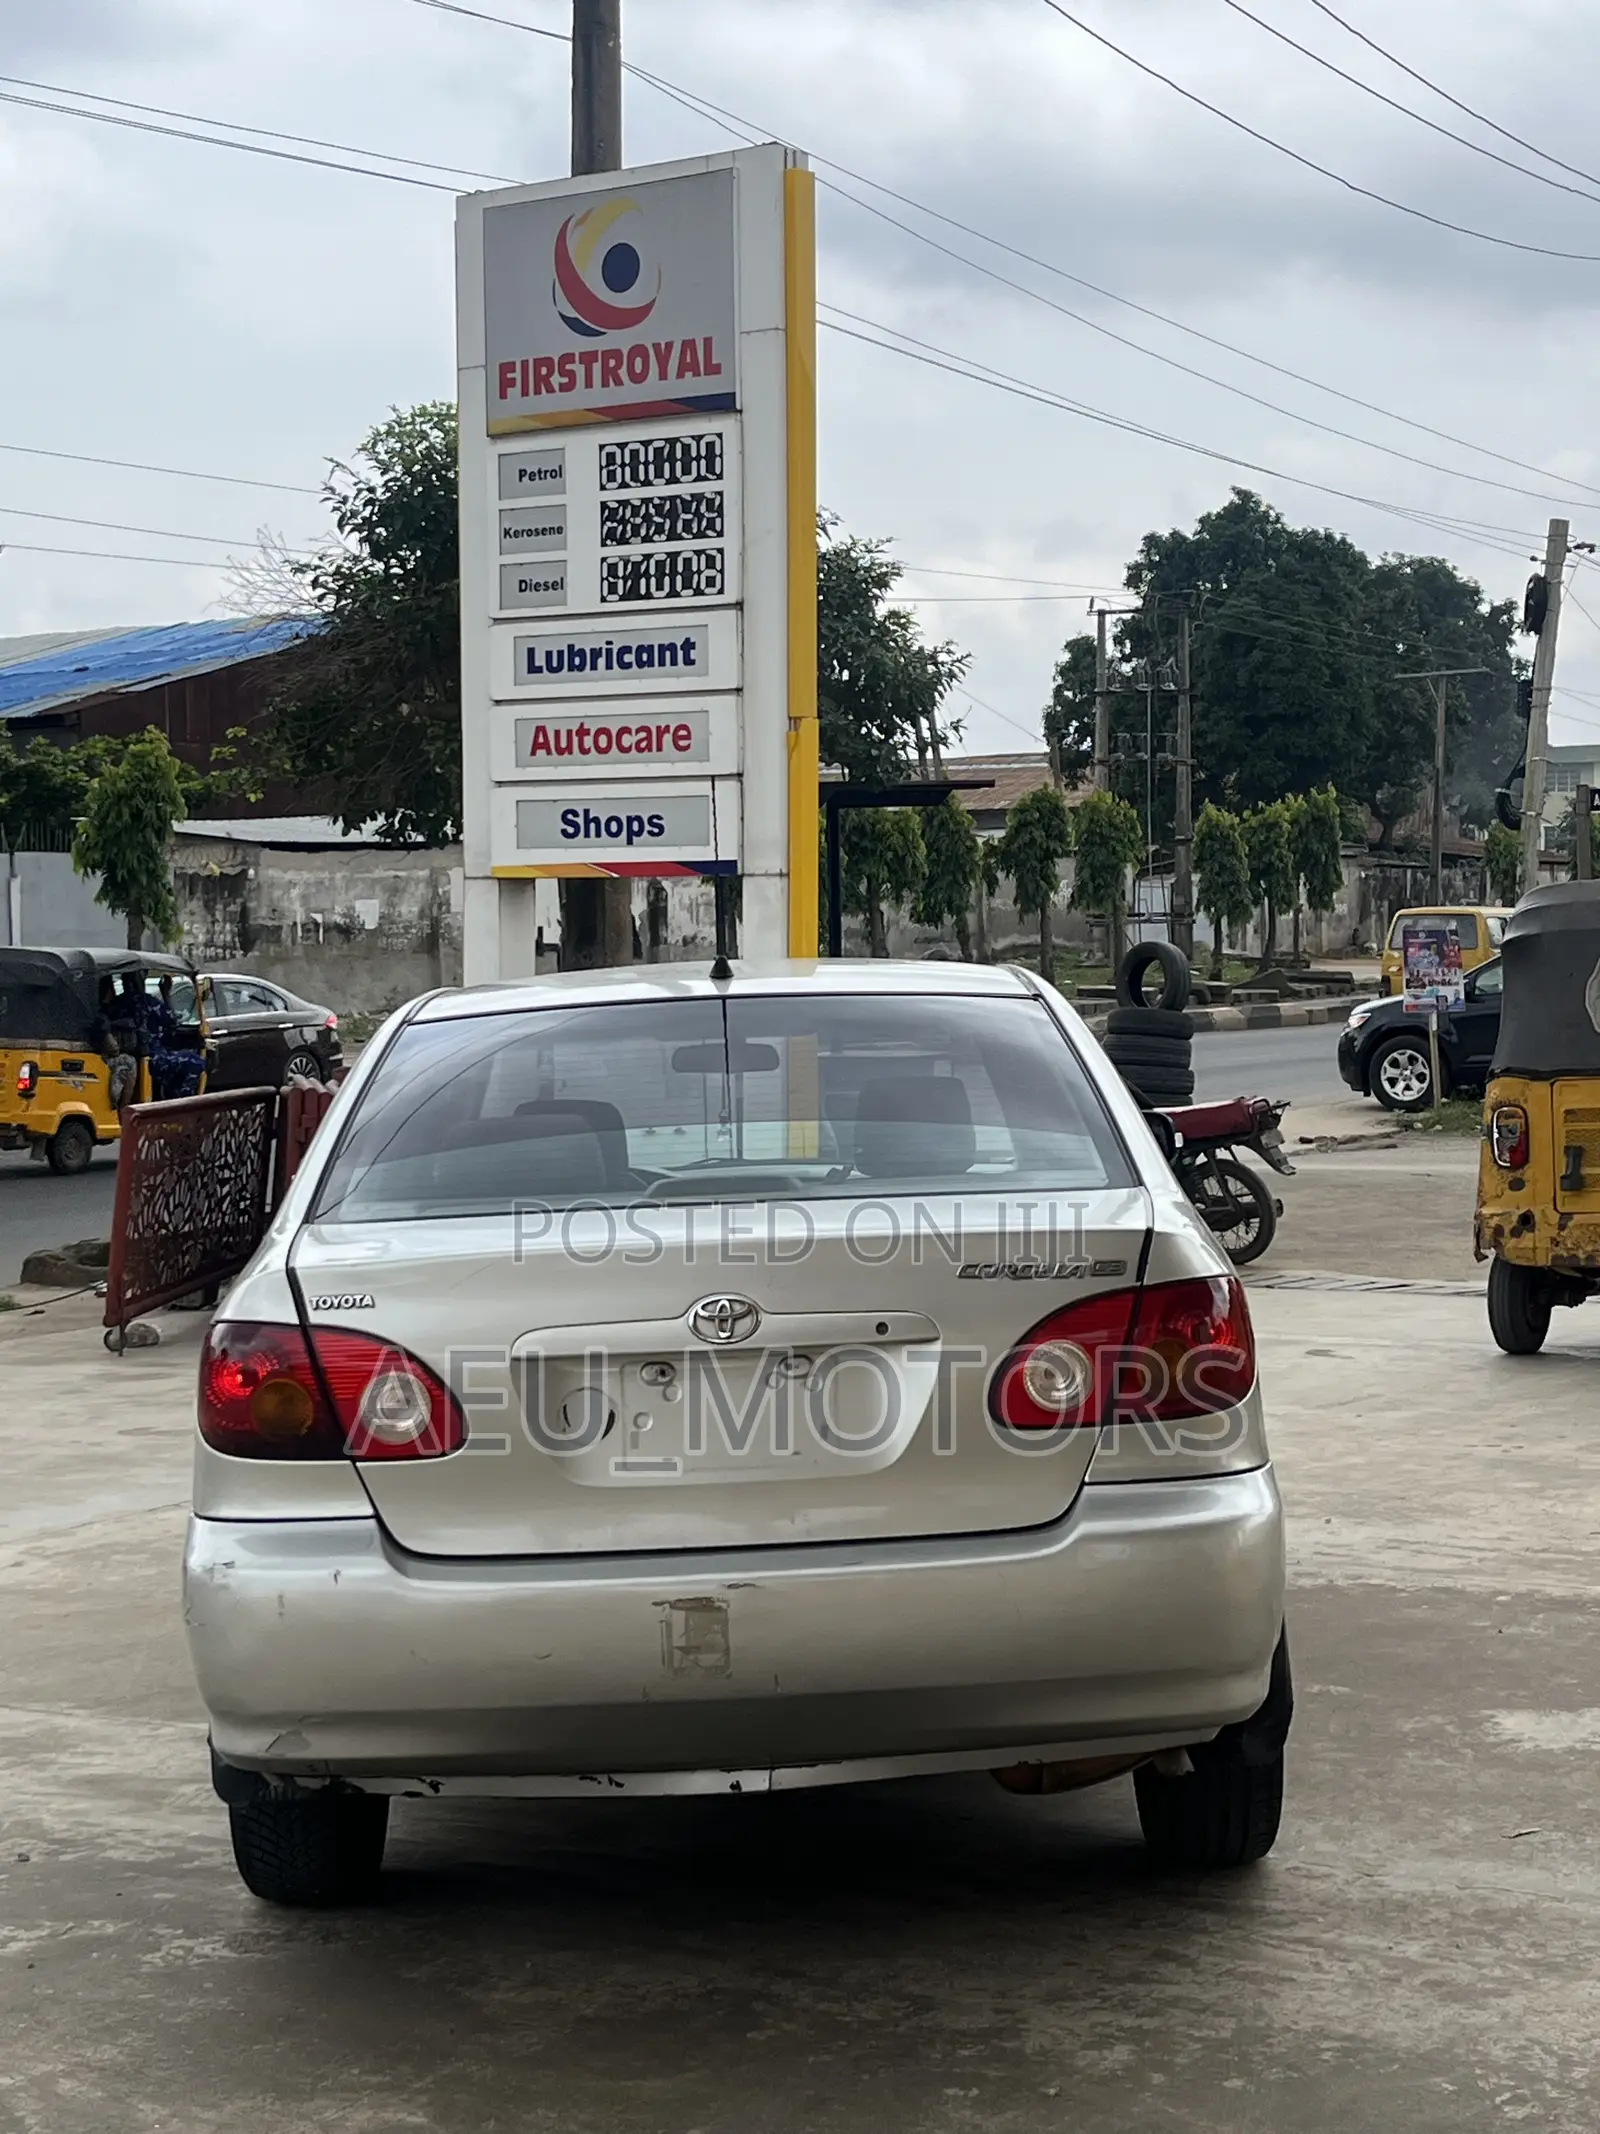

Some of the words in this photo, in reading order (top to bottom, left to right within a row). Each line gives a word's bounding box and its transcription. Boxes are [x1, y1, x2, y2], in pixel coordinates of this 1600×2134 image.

[498, 336, 722, 400] FIRSTROYAL
[518, 464, 563, 483] Petrol
[503, 525, 564, 540] Kerosene
[518, 577, 565, 593] Diesel
[526, 636, 697, 675] Lubricant
[529, 722, 692, 757] Autocare
[560, 808, 665, 846] Shops
[309, 1294, 375, 1311] TOYOTA
